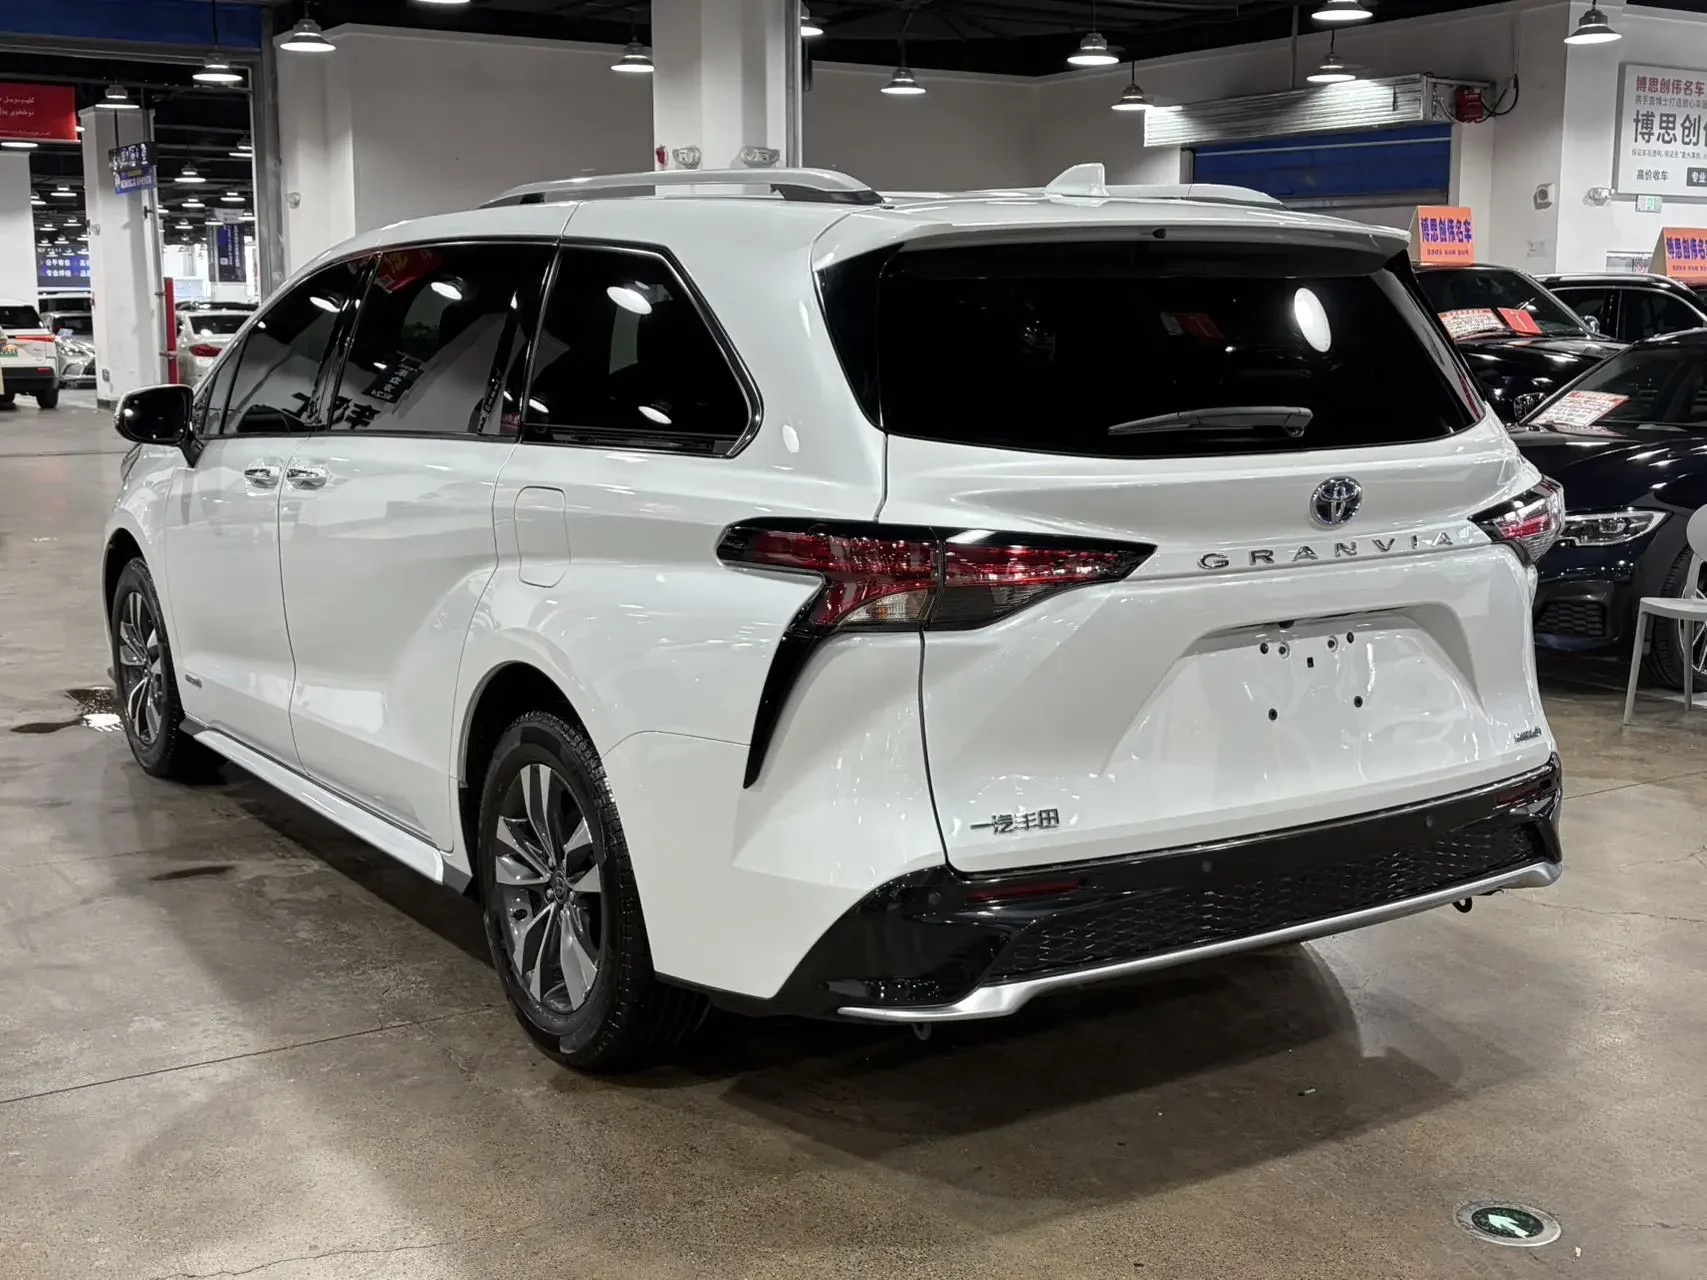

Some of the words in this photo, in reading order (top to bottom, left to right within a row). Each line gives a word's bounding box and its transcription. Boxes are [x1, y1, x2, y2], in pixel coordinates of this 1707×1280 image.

[1636, 75, 1705, 97] 博思创伟名车
[1633, 109, 1707, 147] 博思创
[1636, 168, 1669, 181] 高价收车
[1421, 217, 1472, 243] 博思创伟名车
[1666, 236, 1707, 260] 博思创伟名
[1197, 531, 1454, 570] GRANVIA
[970, 808, 1060, 834] 一汽丰田
